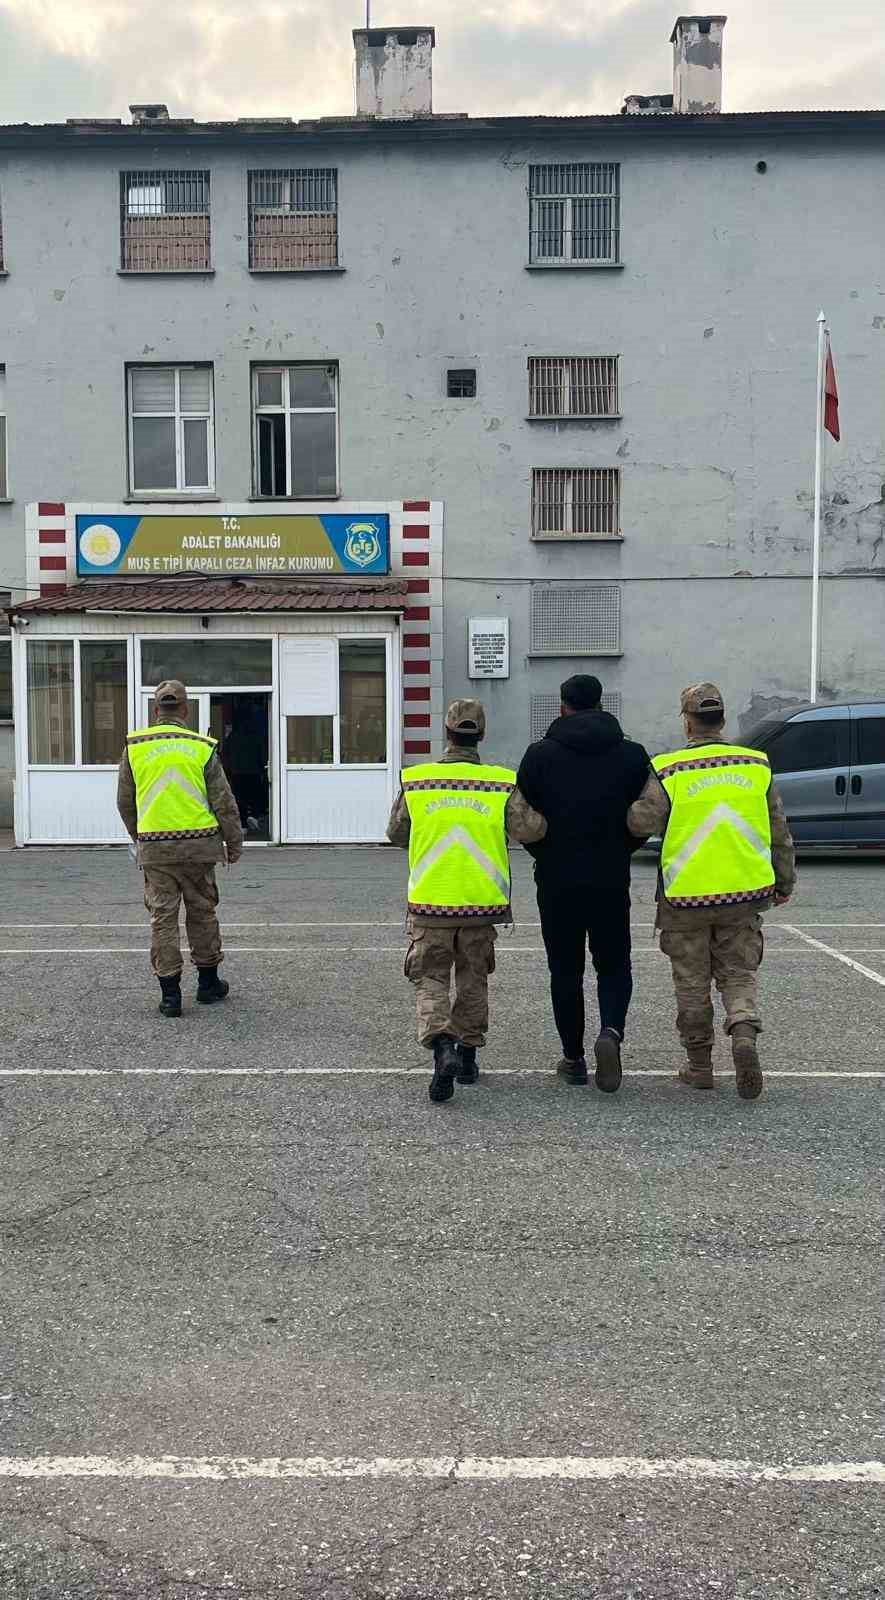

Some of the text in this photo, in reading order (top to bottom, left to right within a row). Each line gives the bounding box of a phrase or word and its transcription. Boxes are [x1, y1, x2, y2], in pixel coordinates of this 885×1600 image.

[222, 517, 241, 530] T.C.
[181, 533, 281, 549] ADALET BAKANLIĞI
[127, 554, 334, 571] MUŞ E TİPİ KAPALI CEZA İNFAZ KURUMU
